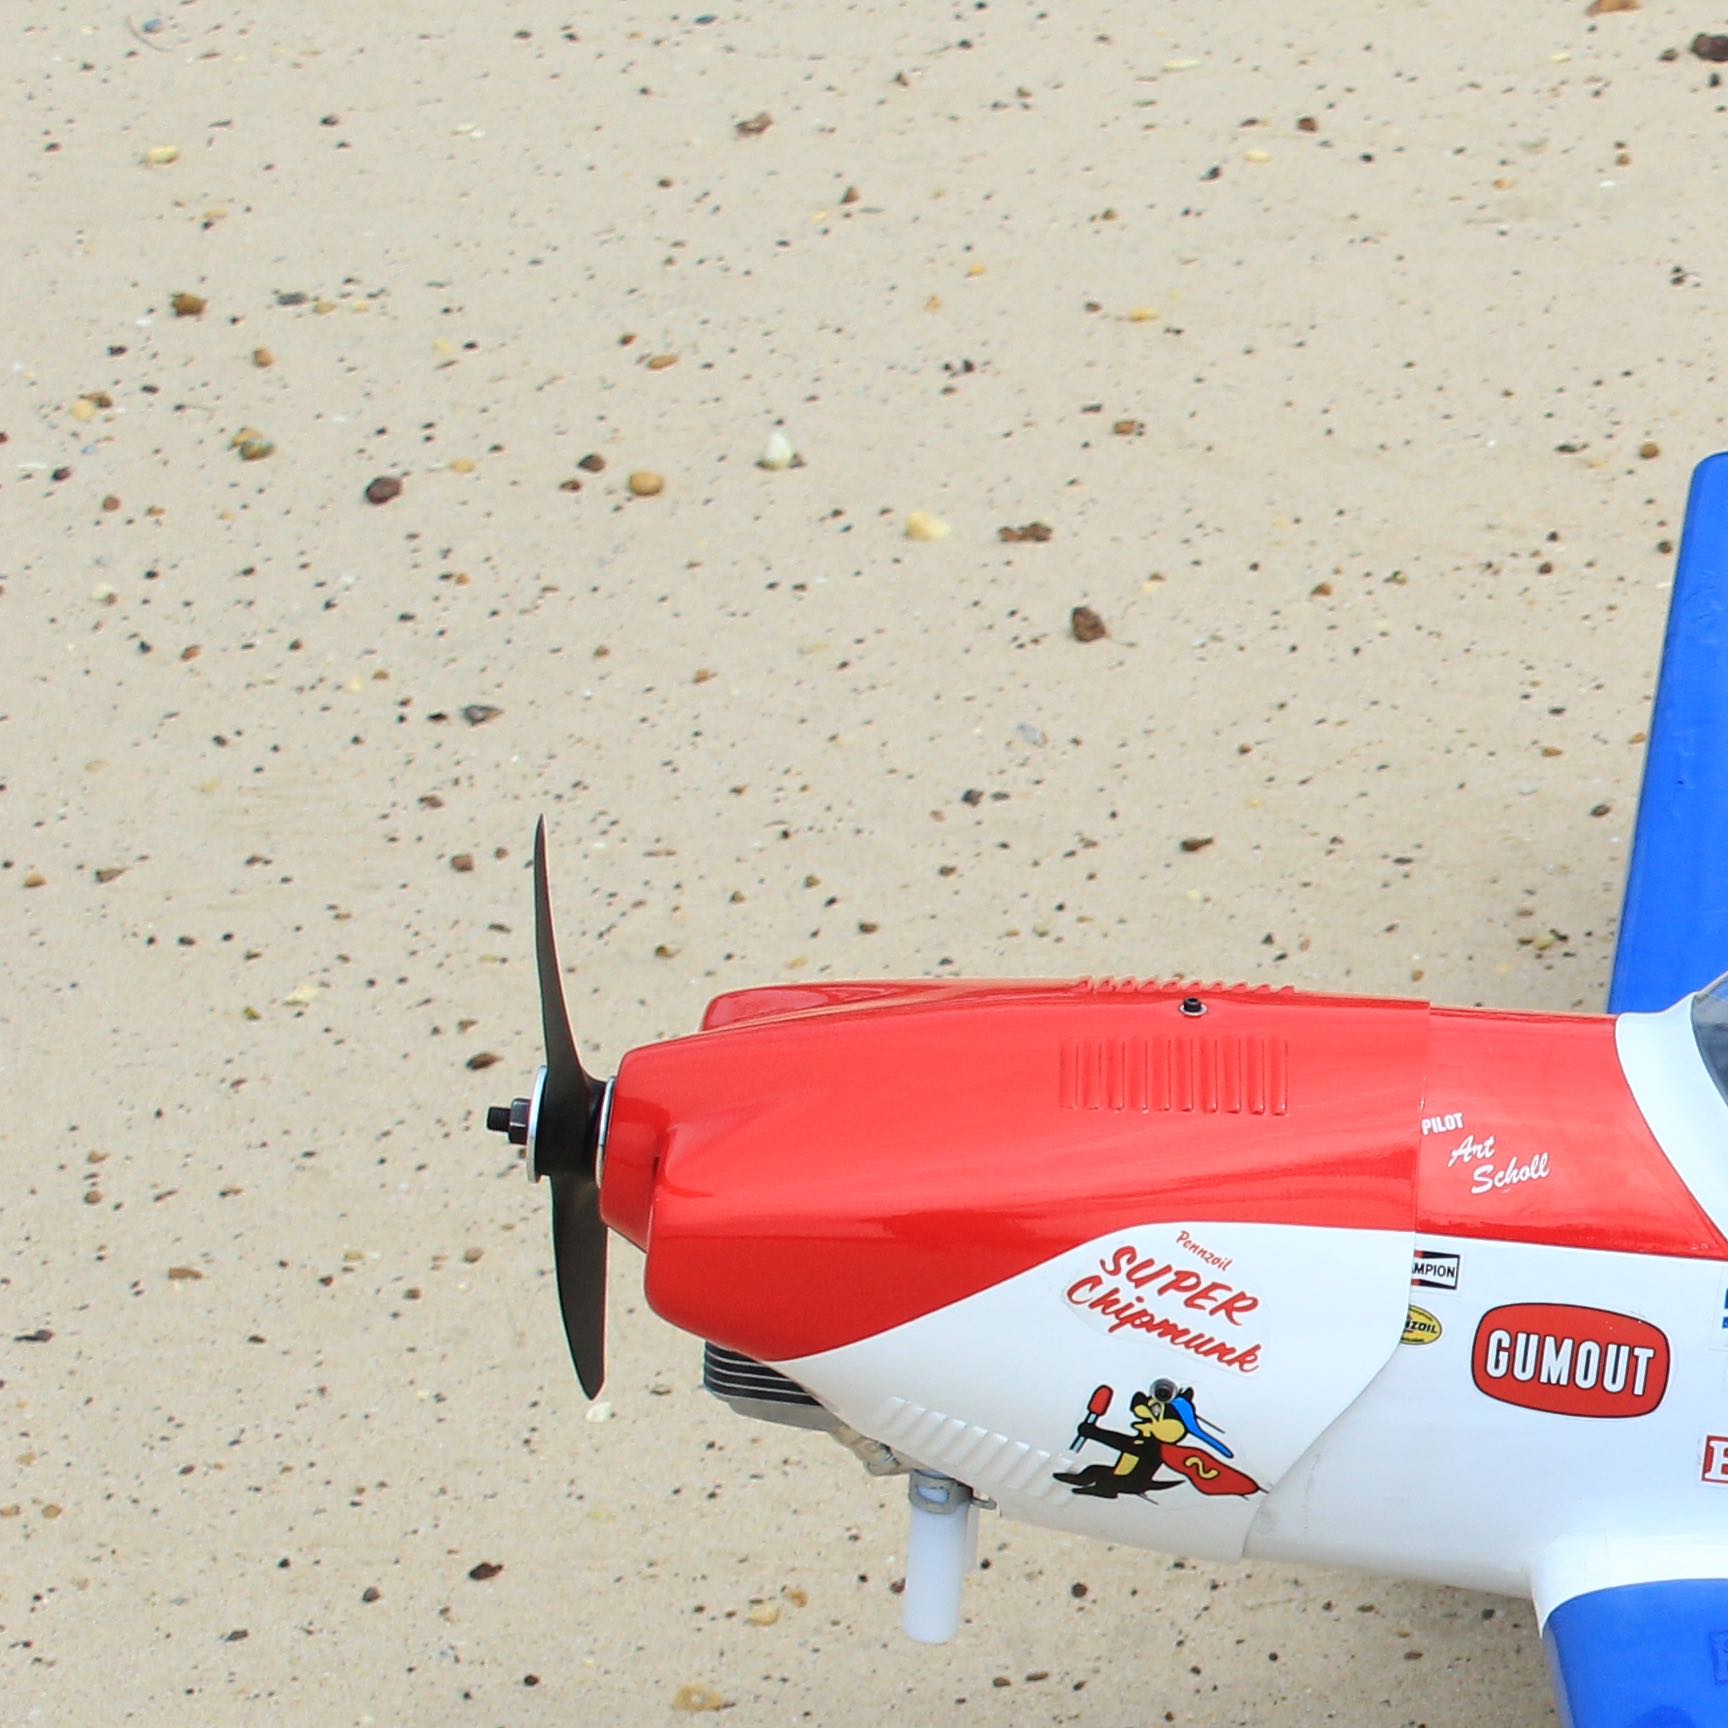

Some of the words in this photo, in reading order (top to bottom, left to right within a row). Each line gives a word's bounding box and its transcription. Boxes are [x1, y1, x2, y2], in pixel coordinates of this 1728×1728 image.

[1421, 1112, 1463, 1135] PILOT
[1447, 1135, 1495, 1167] Art
[1471, 1152, 1550, 1194] Scholl
[1176, 1230, 1233, 1272] Pennzoil
[1099, 1245, 1259, 1326] SUPER
[1066, 1274, 1262, 1373] Chipmunk
[1486, 1328, 1656, 1396] GUMOUT
